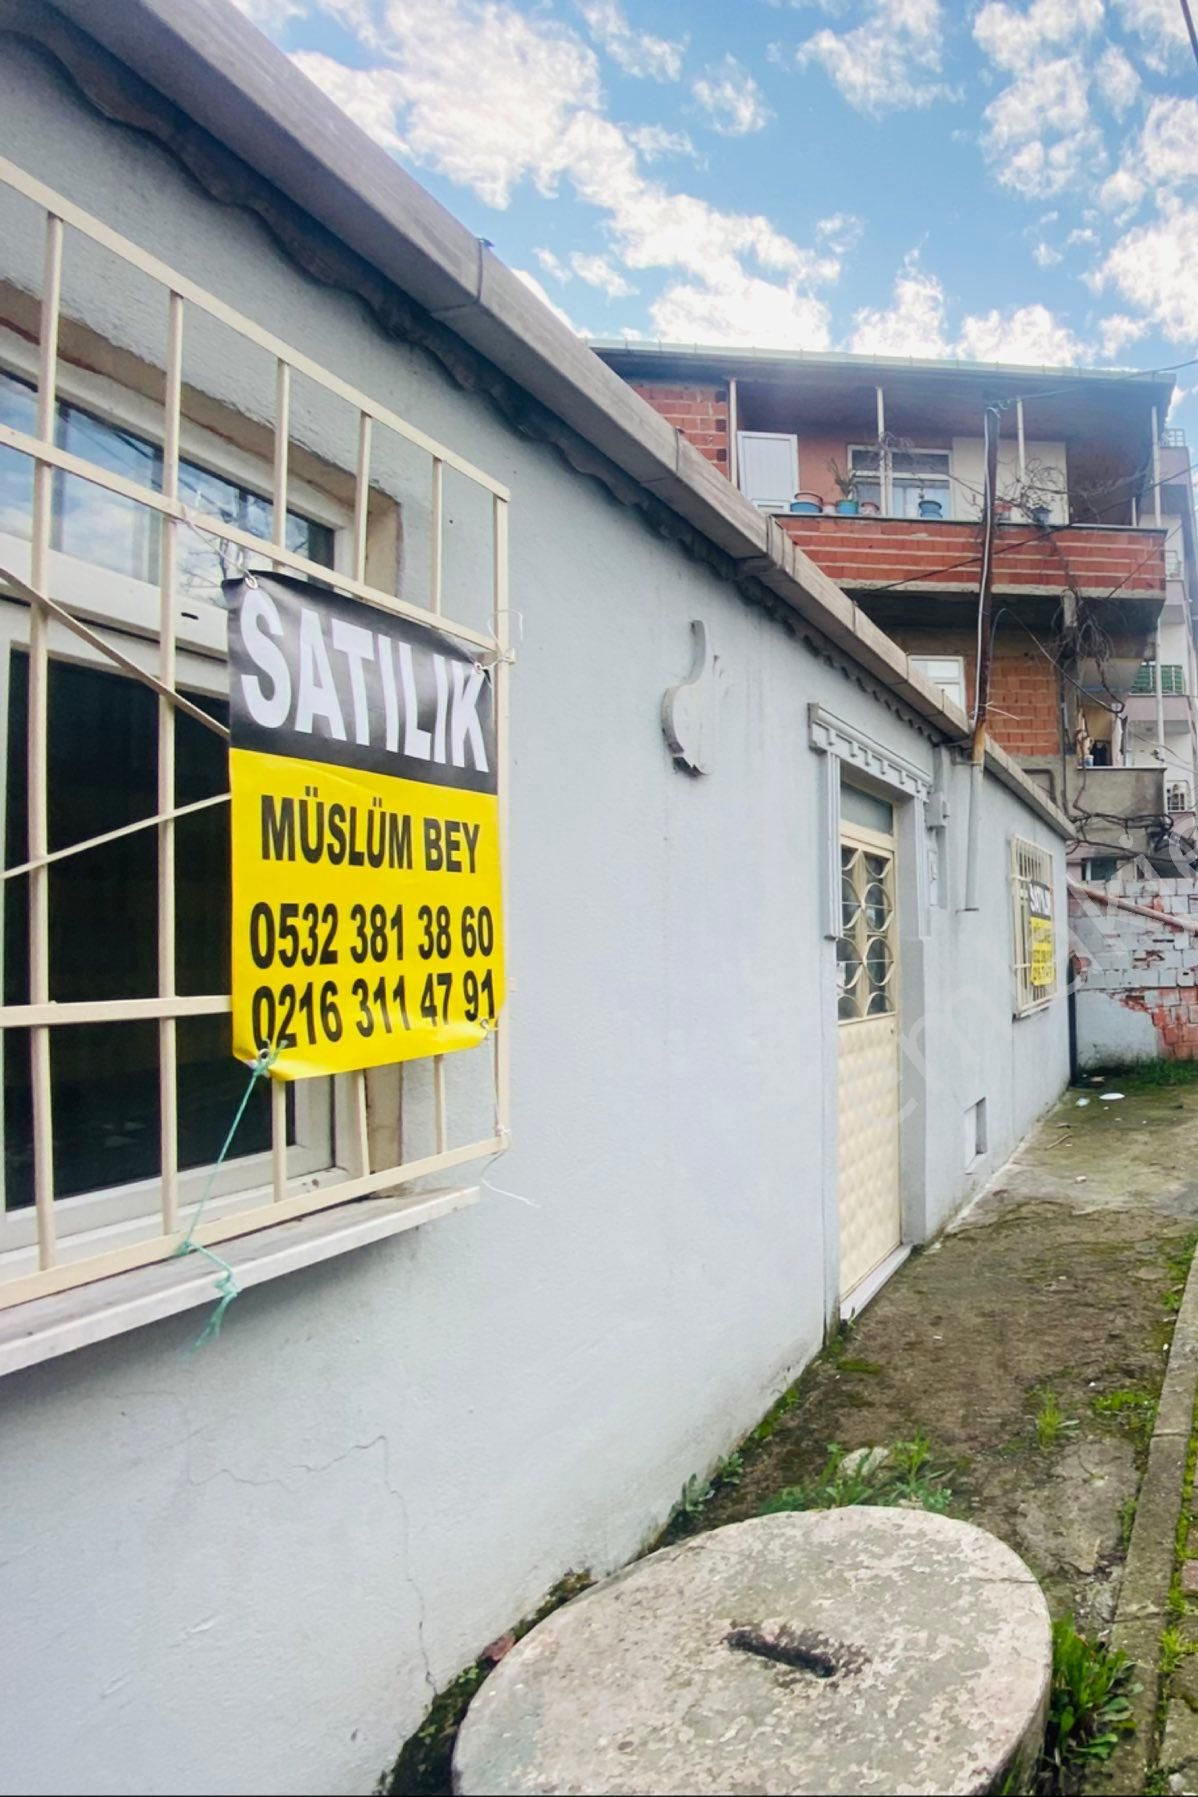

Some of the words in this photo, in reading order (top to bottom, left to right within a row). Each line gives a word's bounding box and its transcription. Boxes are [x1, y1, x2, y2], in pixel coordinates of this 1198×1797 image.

[240, 588, 489, 773] SATILIK
[260, 786, 413, 870] MÜSLÜM
[423, 817, 480, 873] BEY
[250, 901, 339, 969] 0532
[350, 903, 404, 964] 381
[418, 904, 452, 960] 38
[461, 905, 494, 958] 60
[252, 980, 343, 1051] 0216
[351, 975, 411, 1038] 311
[420, 972, 453, 1028] 47
[463, 968, 495, 1023] 91
